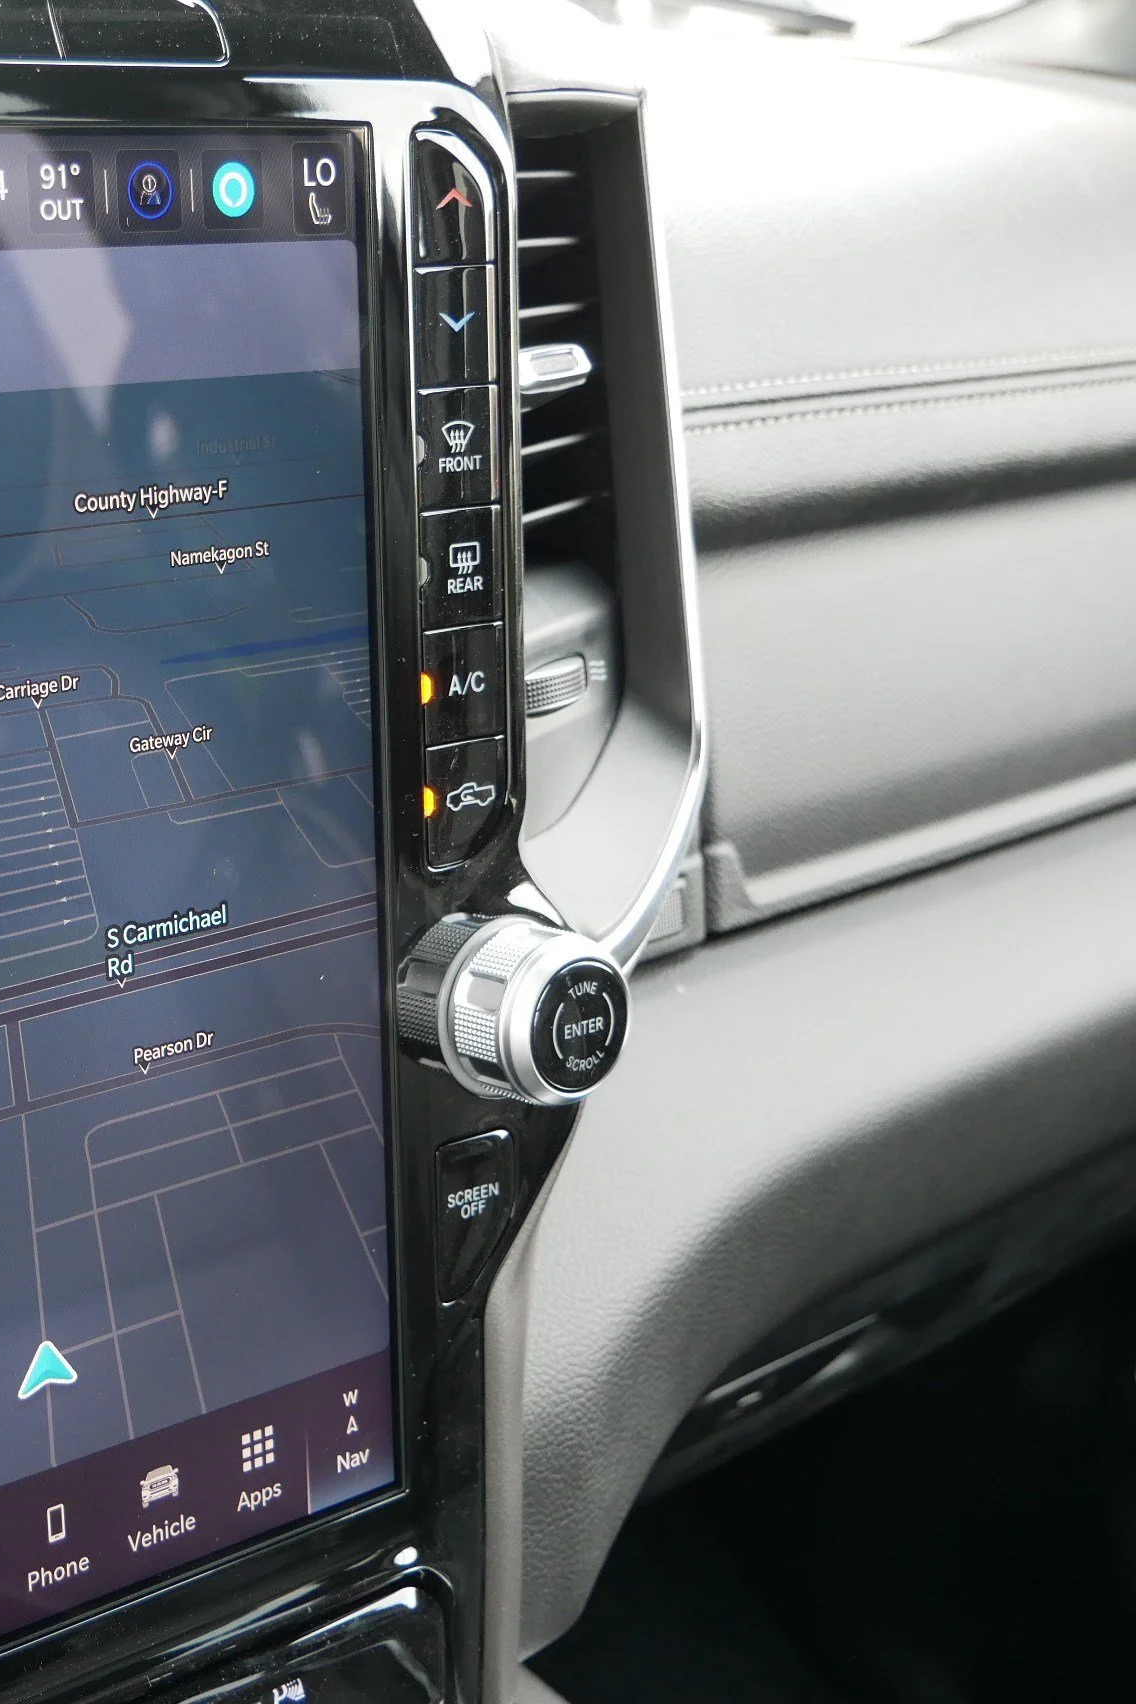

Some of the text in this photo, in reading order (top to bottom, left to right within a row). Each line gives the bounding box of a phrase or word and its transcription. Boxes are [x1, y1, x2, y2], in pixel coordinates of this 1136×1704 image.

[39, 162, 81, 191] 91°
[303, 158, 336, 187] LO
[40, 199, 84, 221] OUT
[438, 455, 483, 474] FRONT
[74, 479, 228, 513] County Highway-F
[170, 541, 269, 567] Namekagon St
[447, 576, 484, 594] REAR
[61, 675, 79, 692] Dr
[448, 670, 486, 697] A/C
[129, 725, 213, 753] Gateway Cir
[107, 904, 227, 948] S Carmichael
[107, 954, 133, 978] Rd
[568, 980, 598, 999] TUNE
[564, 1016, 604, 1040] ENTER
[134, 1032, 214, 1065] Pearson Dr
[566, 1050, 605, 1072] SCROLL
[447, 1182, 500, 1209] SCREEN
[461, 1200, 486, 1219] OFF
[337, 1448, 370, 1474] Nav
[237, 1481, 282, 1512] Apps
[128, 1514, 197, 1552] Vehicle
[28, 1555, 90, 1593] Phone
